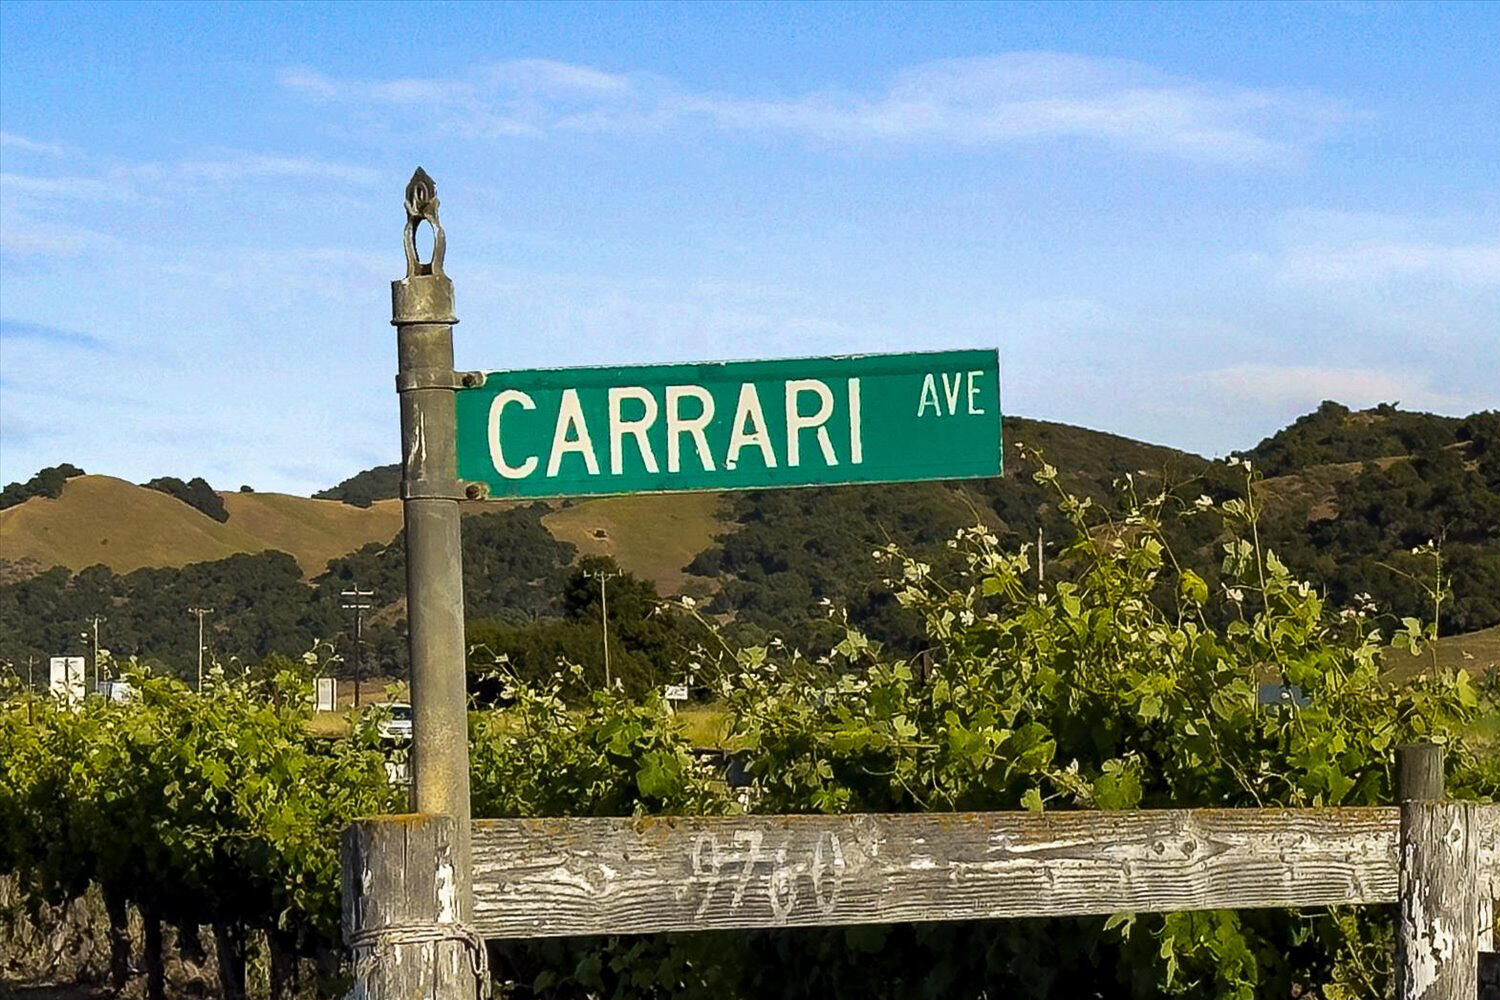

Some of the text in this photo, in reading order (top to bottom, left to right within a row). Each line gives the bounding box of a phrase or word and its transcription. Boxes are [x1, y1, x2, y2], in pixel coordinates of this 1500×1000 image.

[487, 370, 986, 480] CARRARI AVE
[692, 829, 846, 924] 9760
